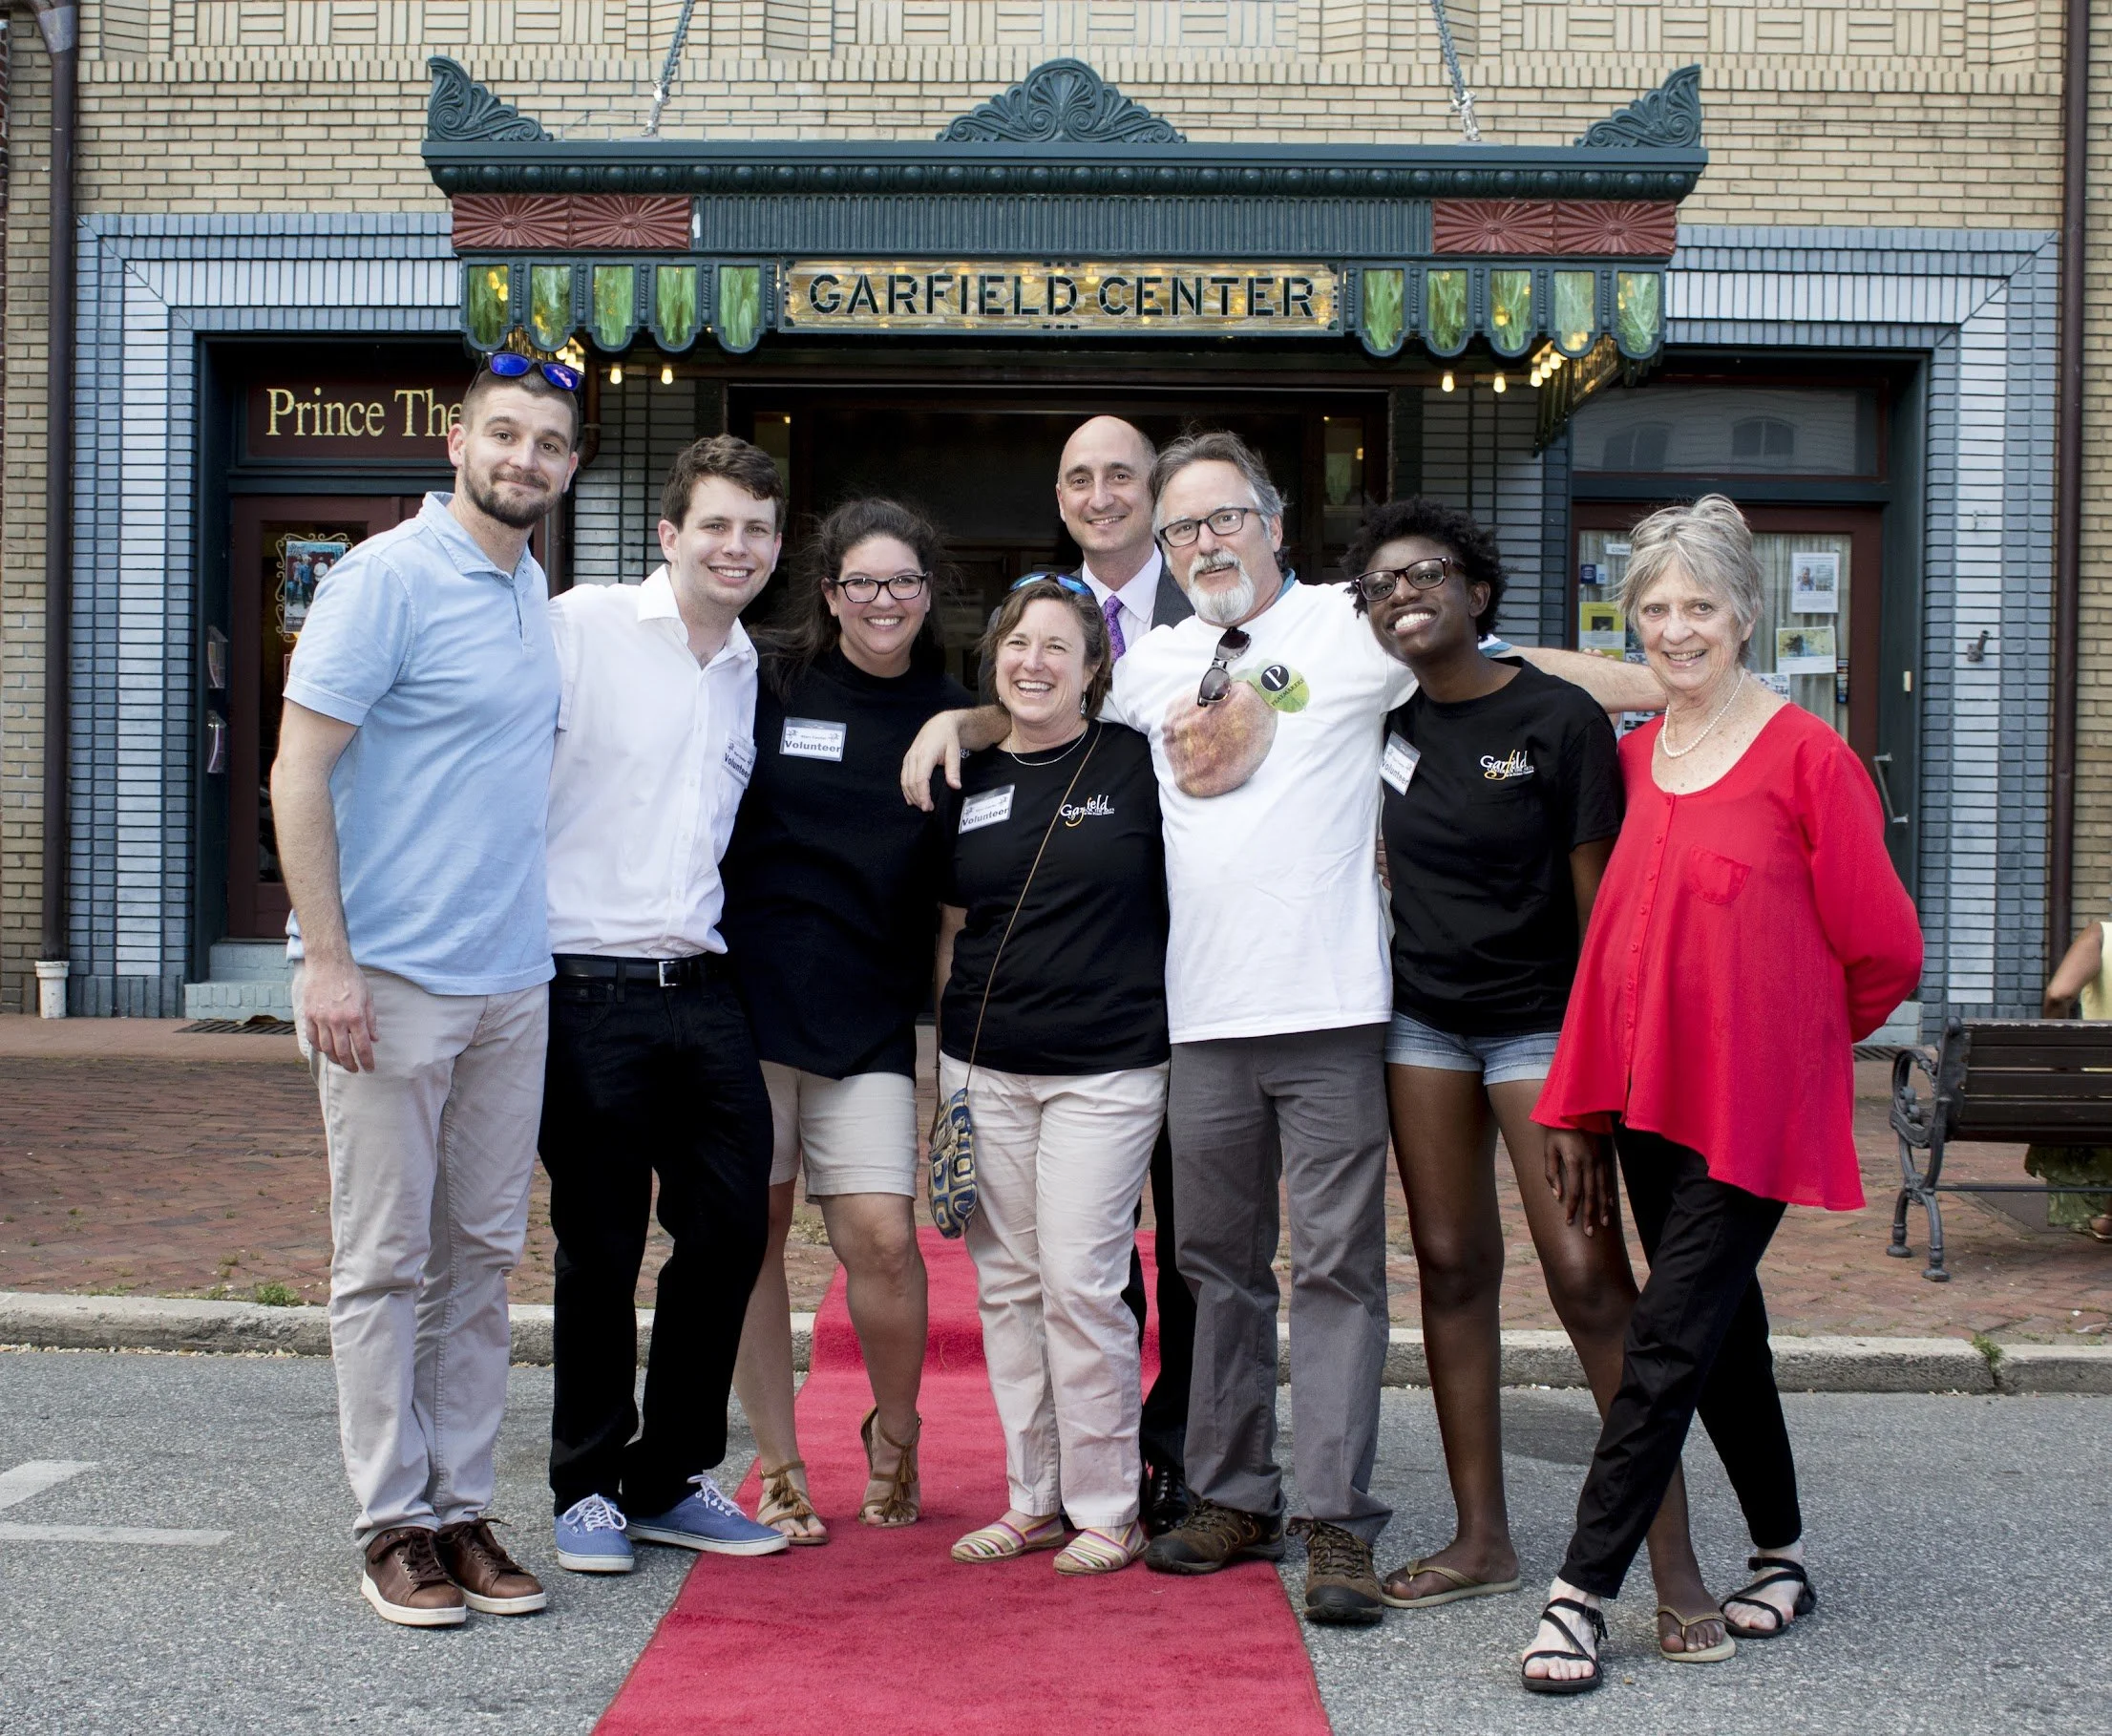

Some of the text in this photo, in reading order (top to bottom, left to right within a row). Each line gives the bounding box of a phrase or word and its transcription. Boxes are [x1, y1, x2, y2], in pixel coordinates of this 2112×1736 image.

[810, 273, 1317, 317] GARFIELD CENTER
[266, 387, 385, 437] Prince
[785, 740, 841, 752] Volunteer
[725, 752, 750, 779] Volunteer
[962, 808, 1008, 826] Volunteer
